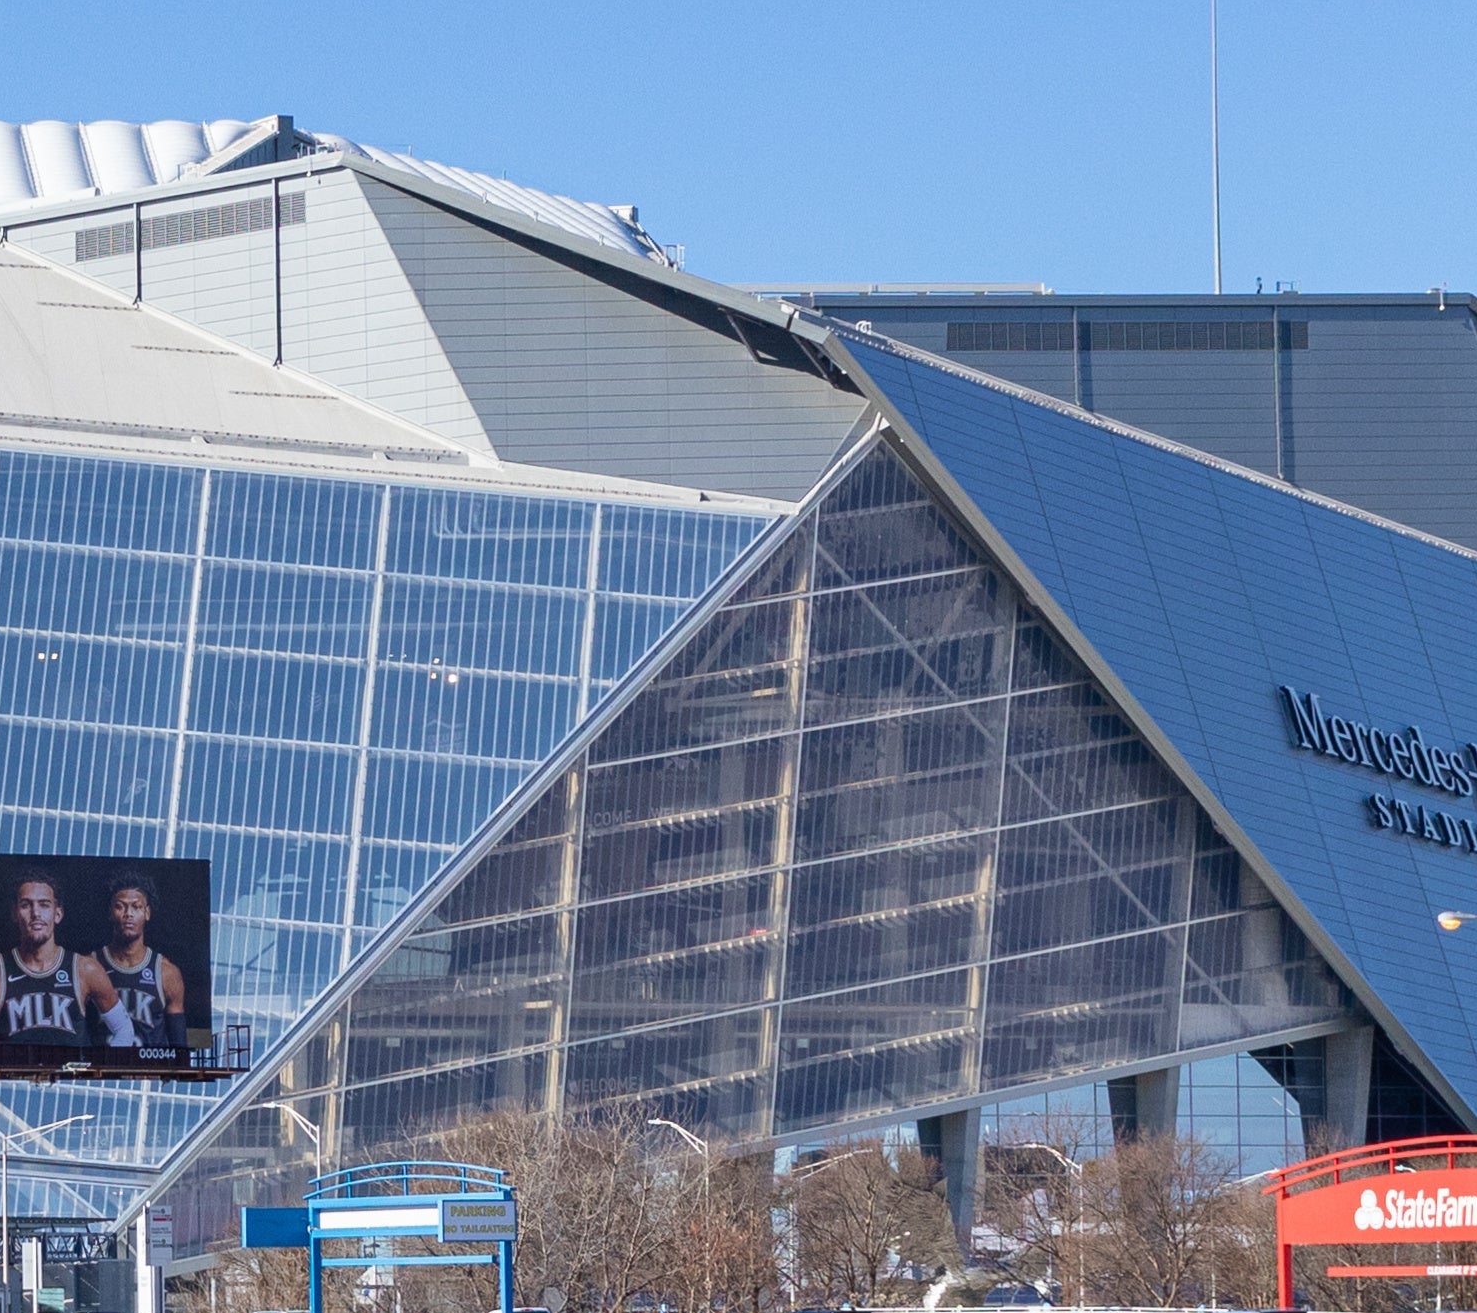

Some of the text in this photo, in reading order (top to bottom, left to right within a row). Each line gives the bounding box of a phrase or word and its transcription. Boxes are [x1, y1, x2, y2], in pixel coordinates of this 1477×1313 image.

[6, 991, 77, 1036] MLK
[118, 988, 156, 1028] LK
[139, 1048, 177, 1059] 000344
[450, 1205, 506, 1217] PARKING
[461, 1224, 514, 1233] TAILGATING
